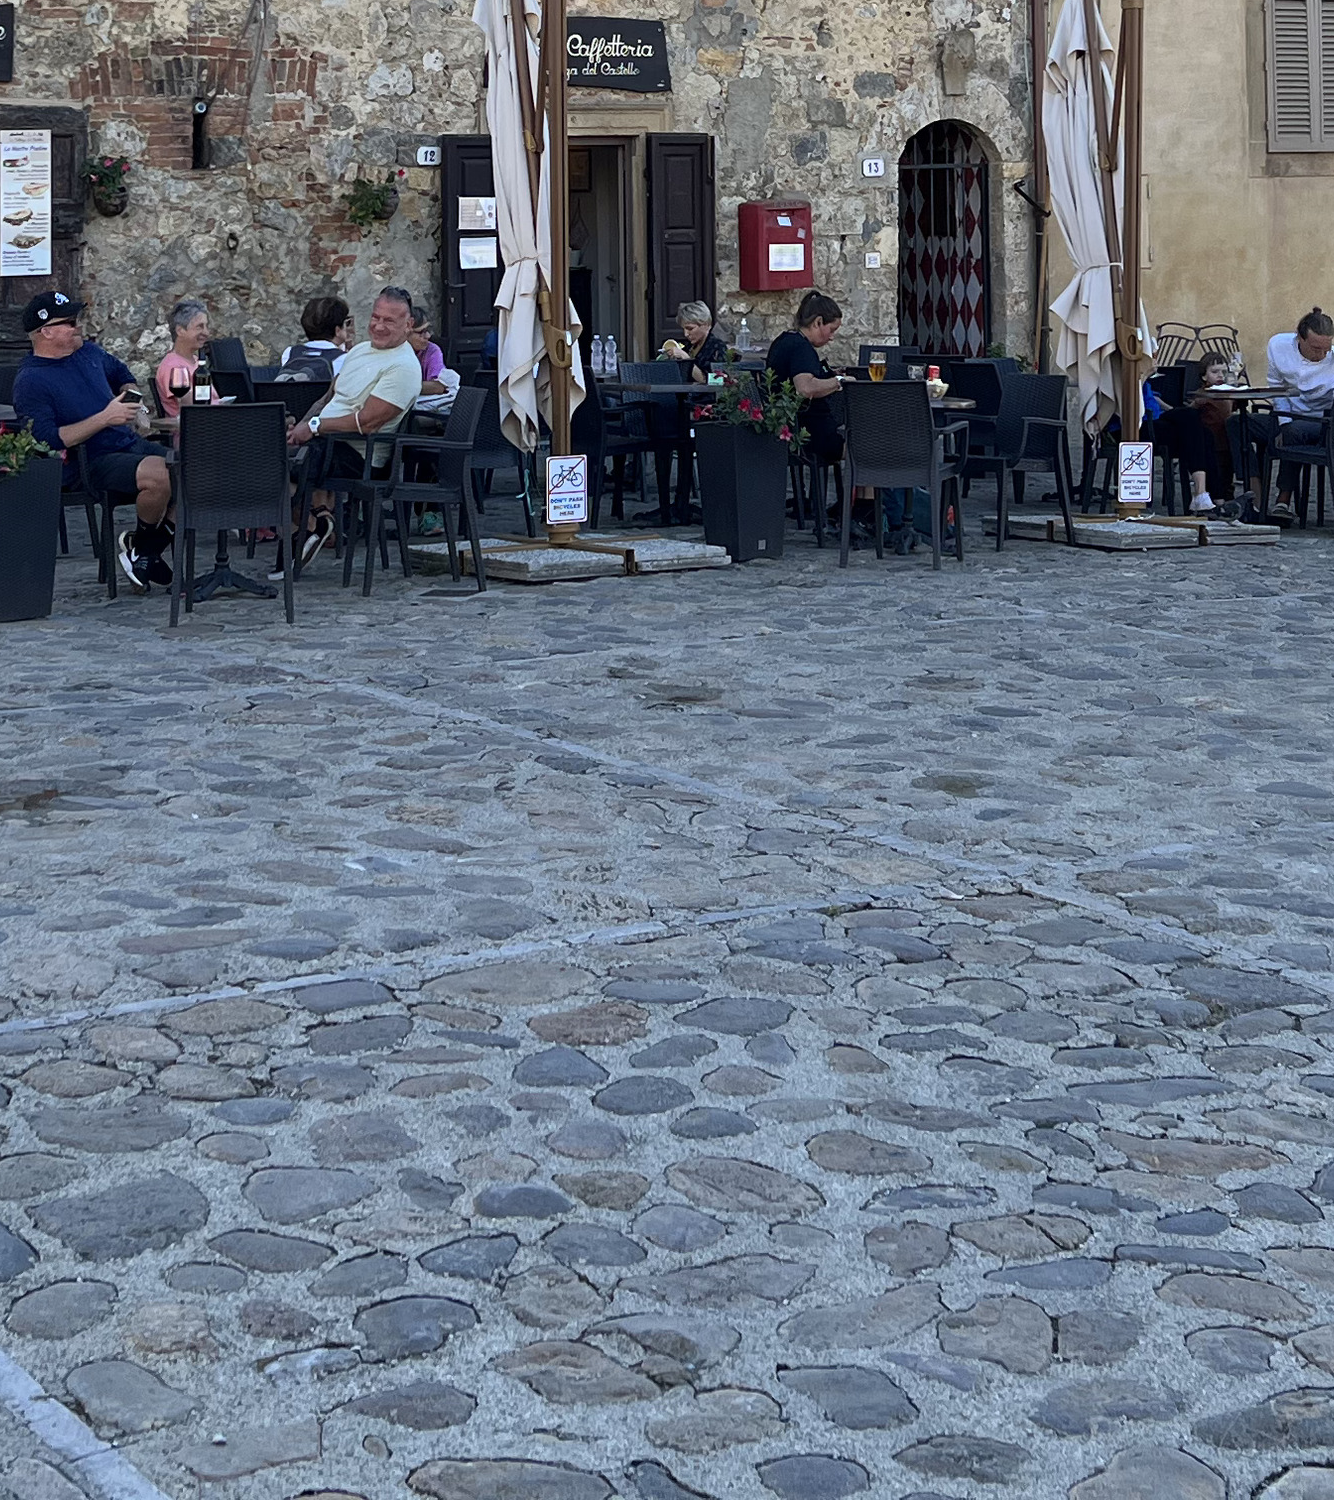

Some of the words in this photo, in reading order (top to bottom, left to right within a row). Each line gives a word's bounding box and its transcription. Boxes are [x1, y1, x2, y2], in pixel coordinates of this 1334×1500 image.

[566, 33, 655, 64] Caffetteria
[600, 62, 641, 76] Castello
[423, 150, 436, 162] 12
[867, 162, 879, 173] 13
